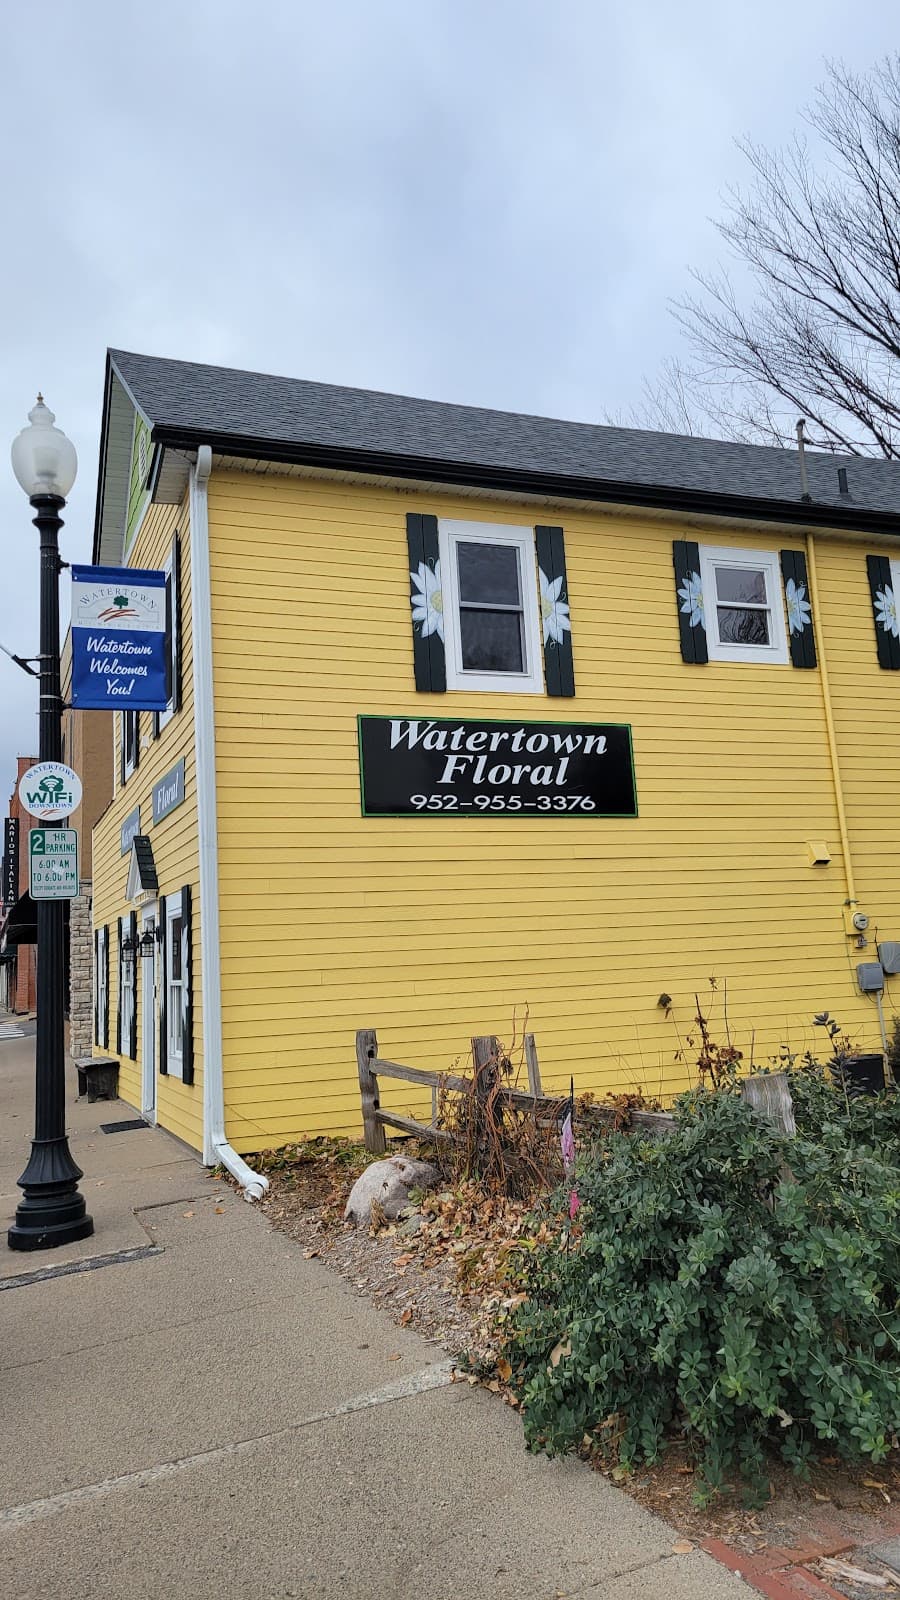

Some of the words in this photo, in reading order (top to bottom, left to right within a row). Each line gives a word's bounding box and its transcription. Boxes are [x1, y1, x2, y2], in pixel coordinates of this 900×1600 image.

[79, 587, 157, 609] WATERTOWN
[87, 636, 153, 655] Watertown
[90, 657, 148, 676] Welcomes
[106, 678, 135, 695] You!
[388, 719, 608, 755] Watertown
[26, 764, 76, 780] WATERTOWN
[436, 754, 570, 786] Floral
[157, 771, 179, 814] Floral
[410, 794, 596, 811] 952-955-3376
[32, 834, 44, 852] 2
[54, 832, 67, 842] HR
[46, 843, 76, 853] PARKING
[59, 859, 70, 869] AM
[33, 872, 42, 882] TO
[65, 872, 76, 881] PM
